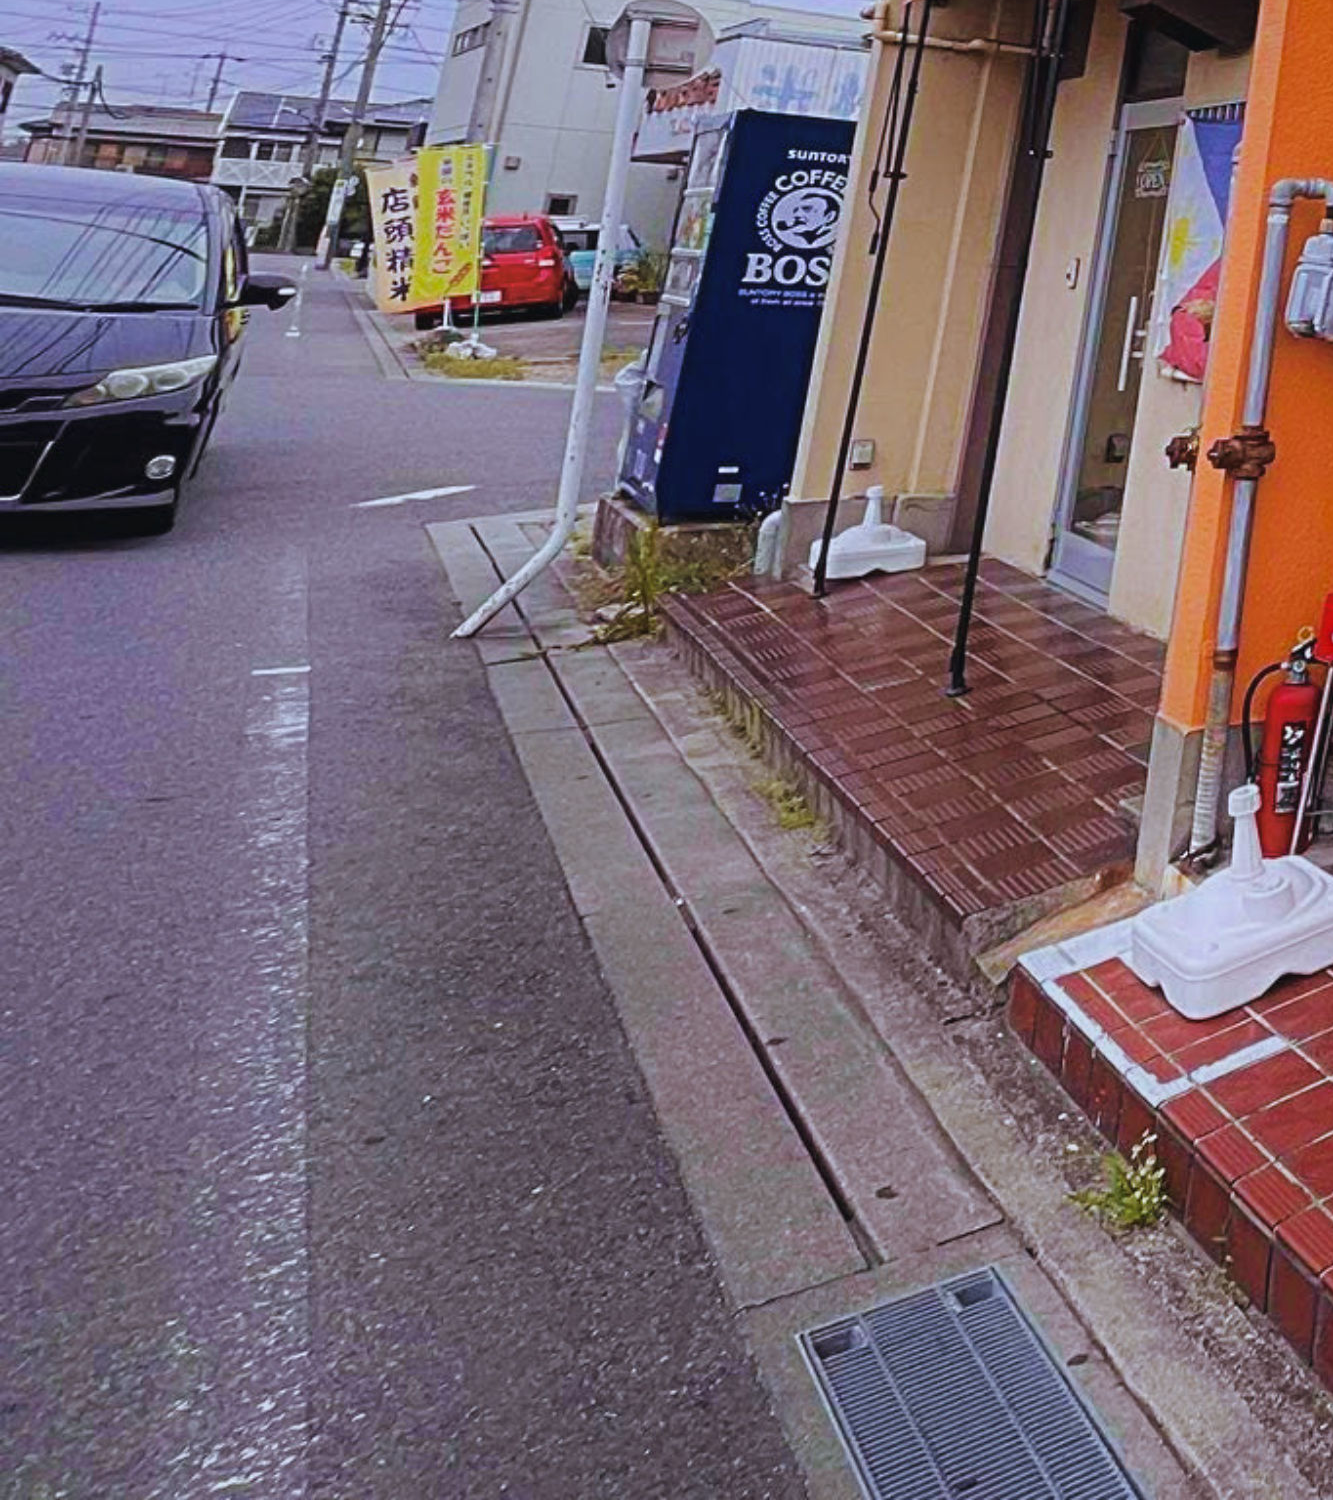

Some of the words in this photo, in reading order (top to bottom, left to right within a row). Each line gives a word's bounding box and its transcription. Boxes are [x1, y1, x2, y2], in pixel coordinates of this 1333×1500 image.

[787, 149, 852, 164] SUNTOR
[774, 168, 849, 193] COFFE
[381, 187, 415, 302] 店頭精米
[741, 253, 832, 287] BOS
